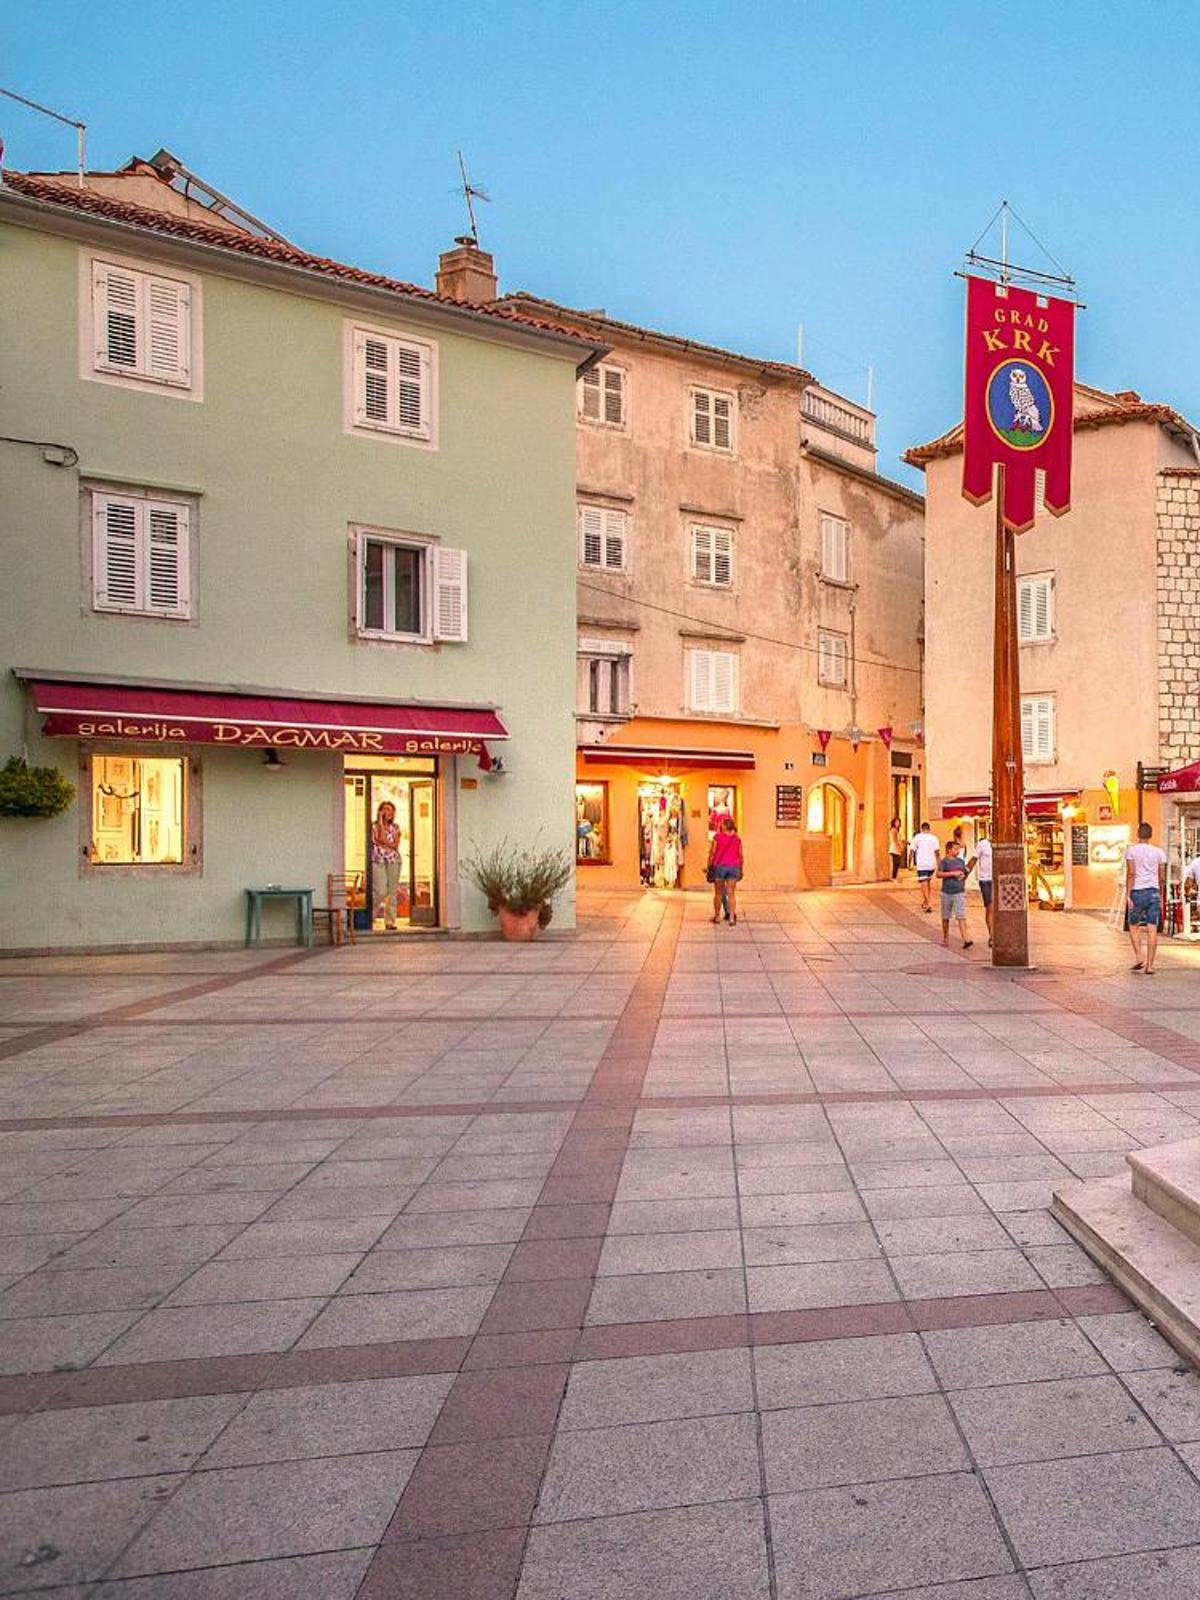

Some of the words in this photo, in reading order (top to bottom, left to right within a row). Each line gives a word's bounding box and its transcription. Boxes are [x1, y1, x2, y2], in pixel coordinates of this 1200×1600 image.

[994, 308, 1049, 333] GRAD
[982, 328, 1061, 368] KRK
[78, 719, 187, 741] galerija
[213, 724, 384, 750] DAGMAR
